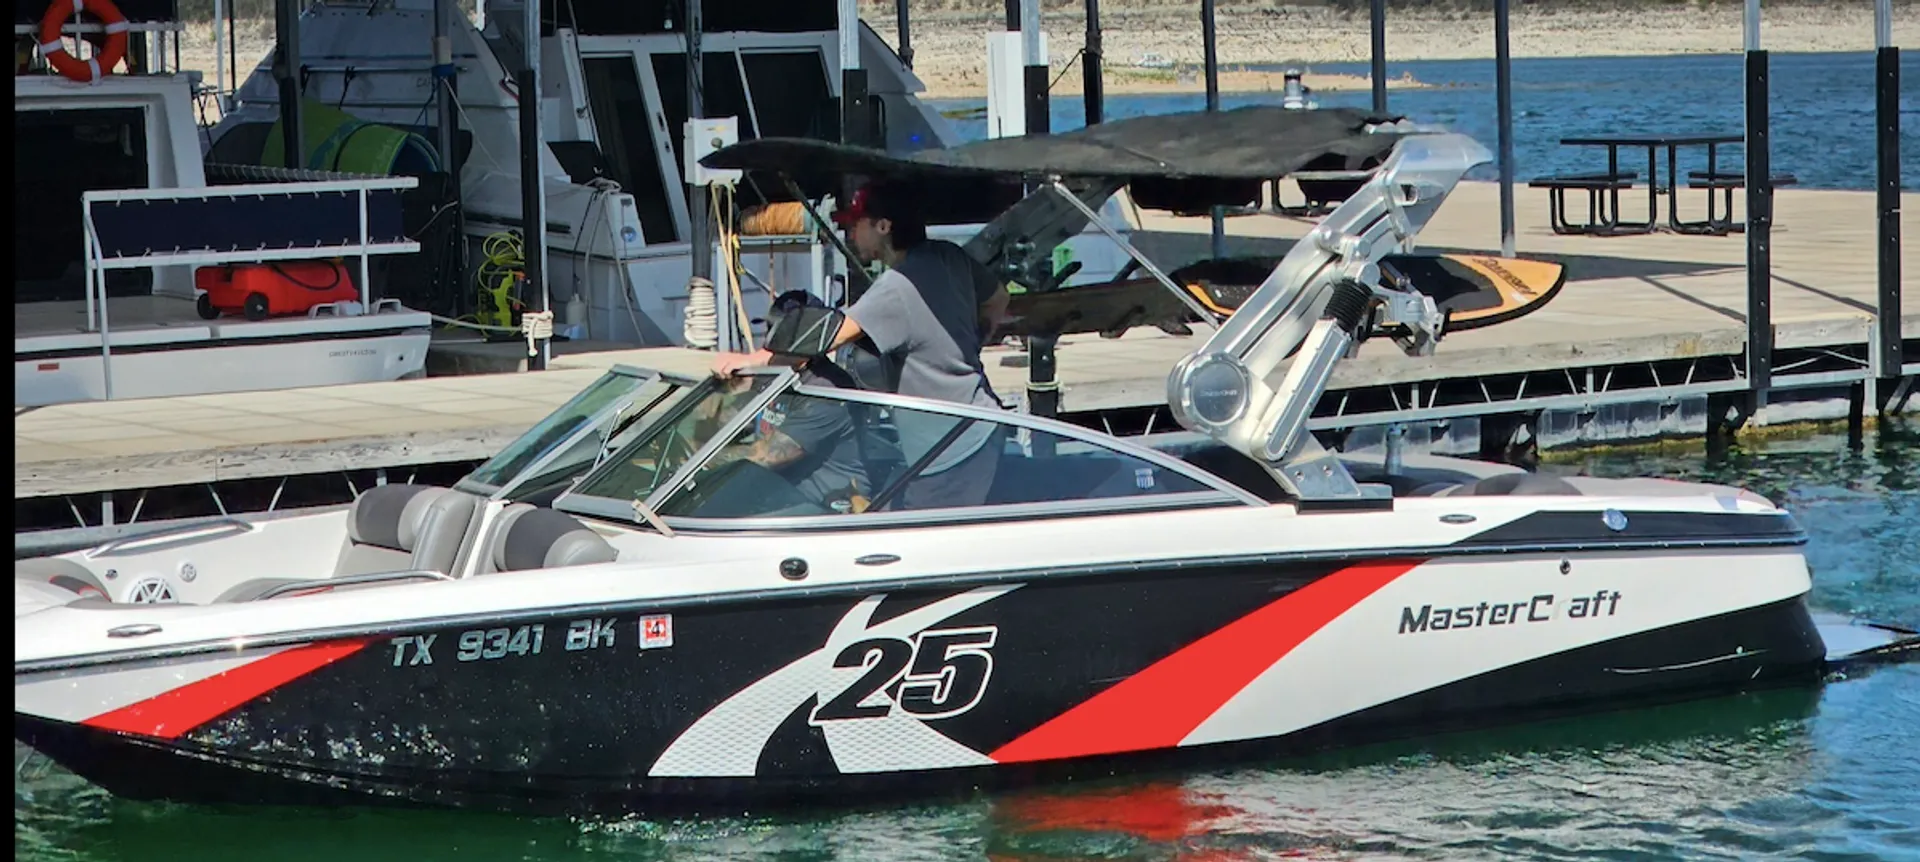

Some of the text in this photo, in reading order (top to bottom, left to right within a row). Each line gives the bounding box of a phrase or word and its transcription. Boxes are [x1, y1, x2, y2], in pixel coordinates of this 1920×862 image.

[390, 618, 617, 667] TX 9341 BK
[808, 626, 997, 727] 25
